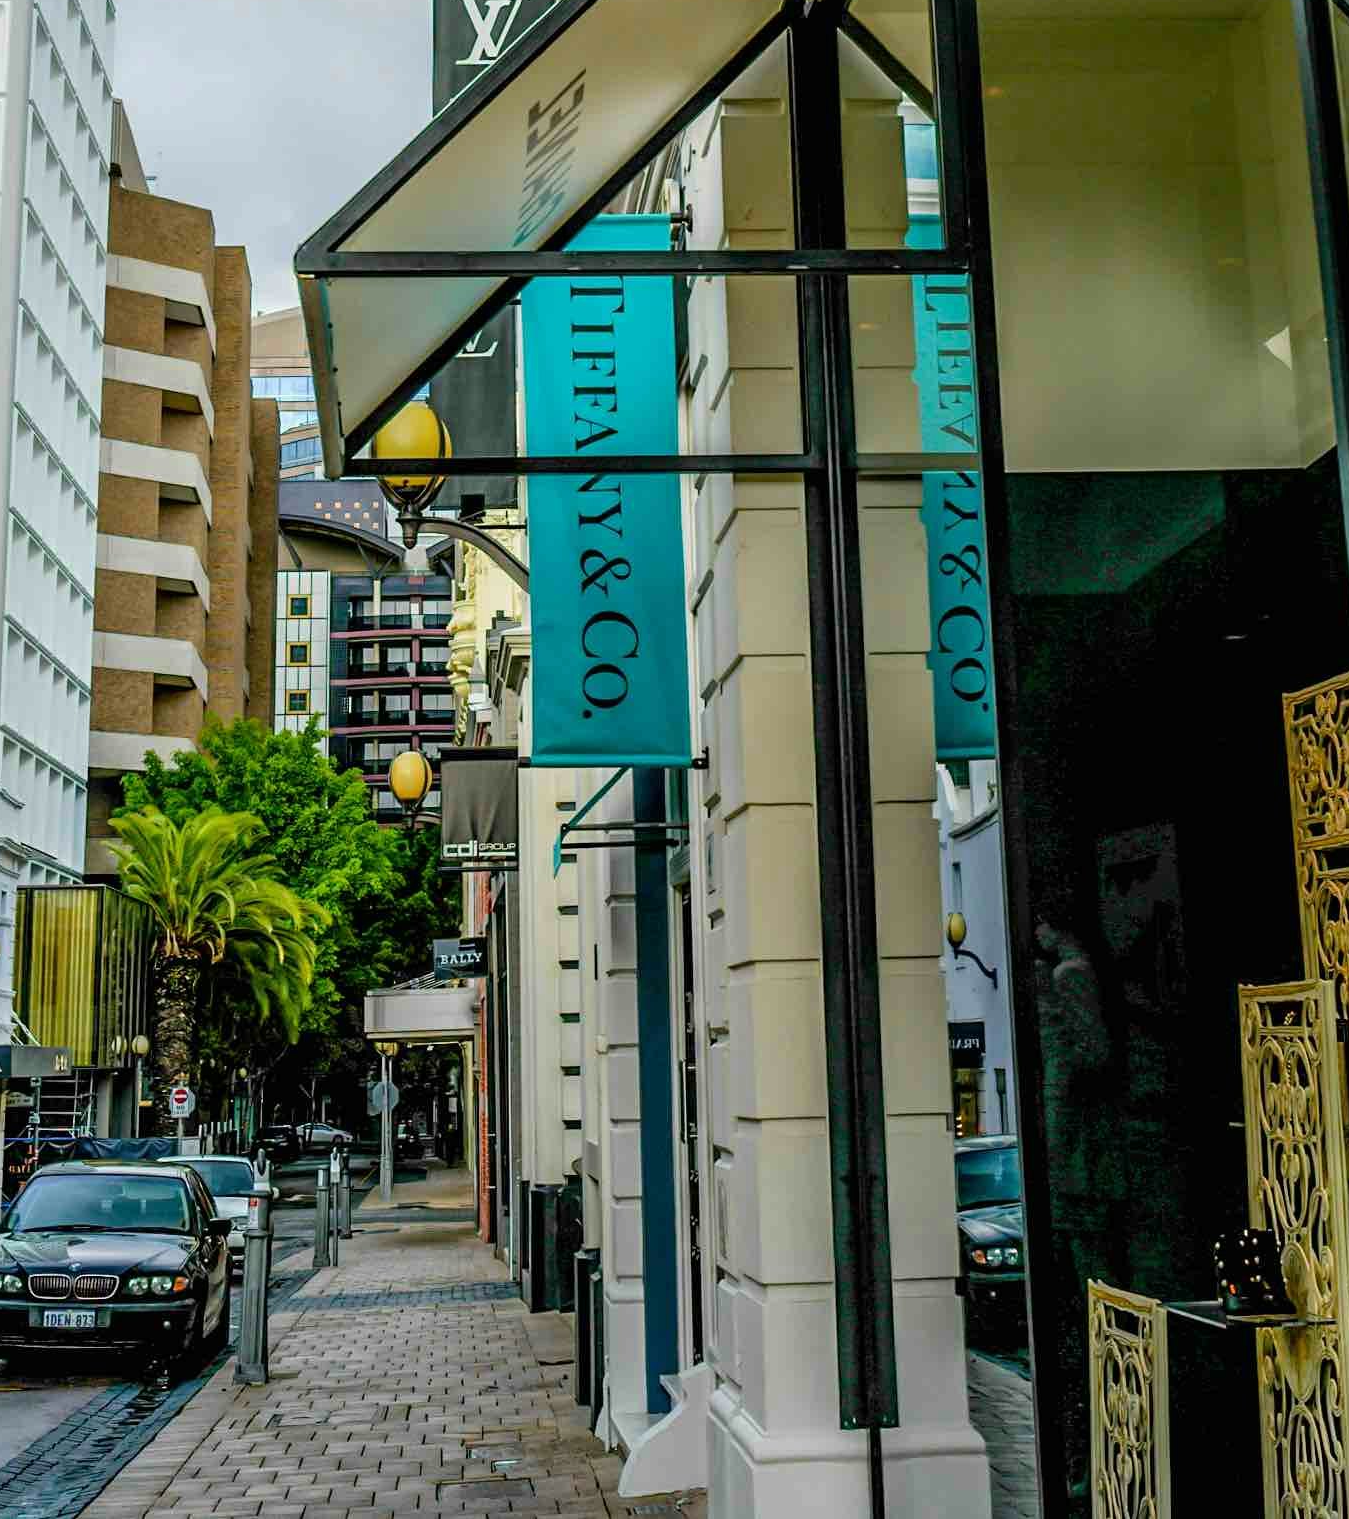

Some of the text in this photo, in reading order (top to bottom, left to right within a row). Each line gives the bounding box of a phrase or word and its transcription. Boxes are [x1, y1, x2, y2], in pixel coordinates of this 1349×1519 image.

[580, 548, 633, 597] &
[479, 842, 516, 851] GROUP
[441, 952, 483, 964] BALLY
